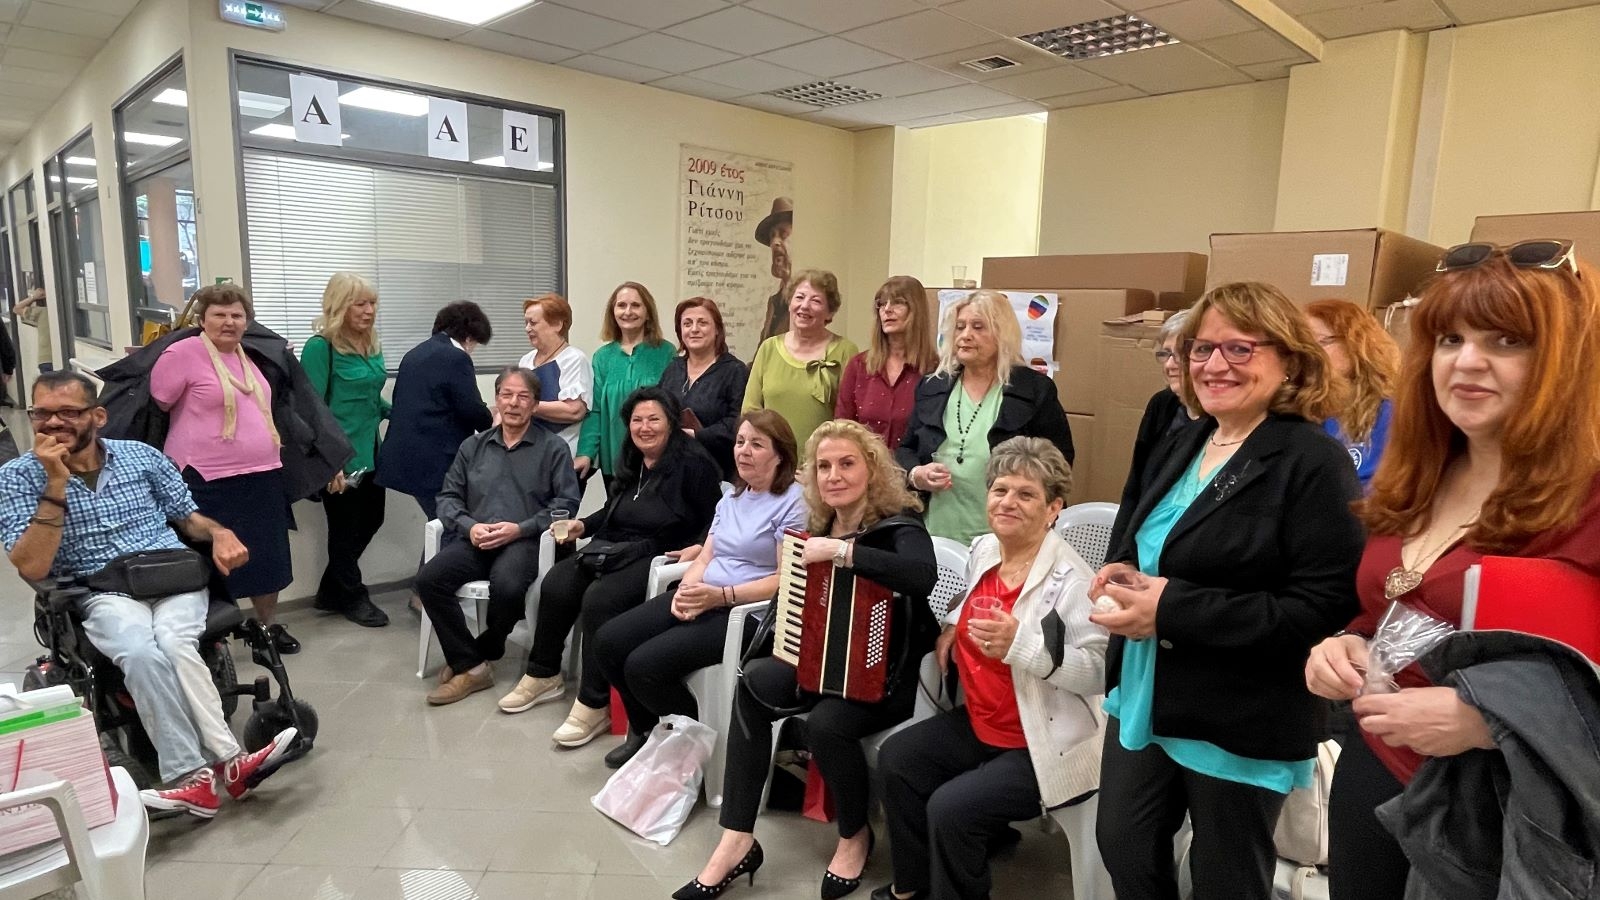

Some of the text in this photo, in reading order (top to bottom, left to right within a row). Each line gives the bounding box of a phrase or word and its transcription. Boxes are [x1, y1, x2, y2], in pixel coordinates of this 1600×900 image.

[688, 157, 717, 176] 2009
[720, 163, 745, 184] έτος
[688, 179, 744, 206] Γιάννη
[688, 200, 743, 222] Ρίτσου
